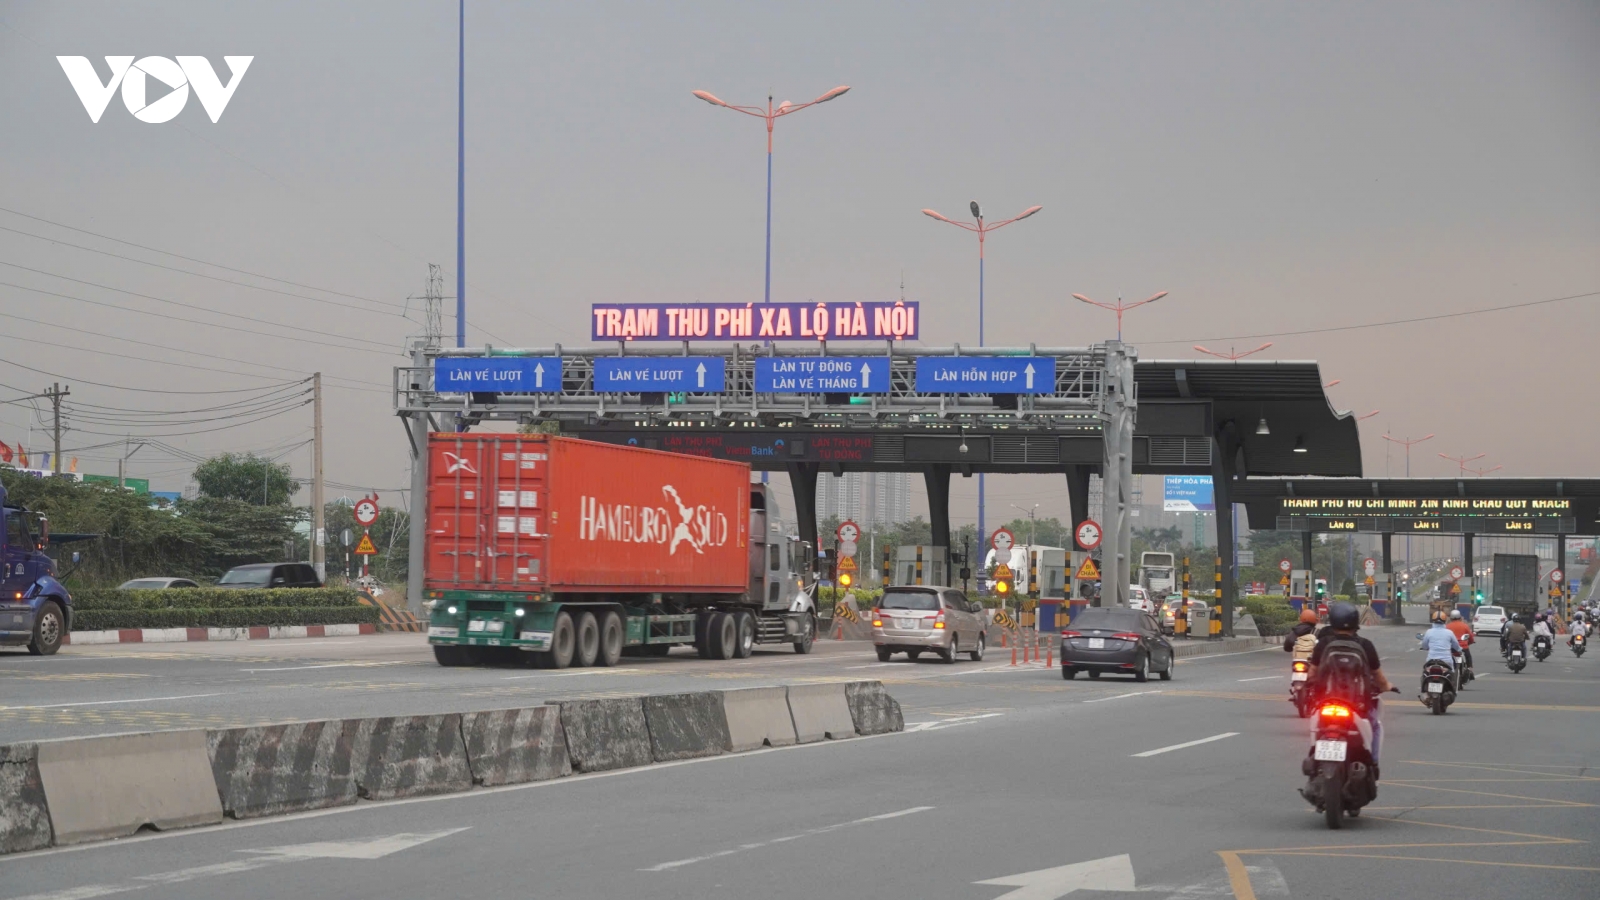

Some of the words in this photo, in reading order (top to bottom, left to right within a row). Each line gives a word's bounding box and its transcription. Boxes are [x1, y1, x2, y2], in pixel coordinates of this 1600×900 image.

[594, 308, 658, 341] TRẠM
[665, 308, 709, 337] THU
[714, 302, 753, 337] PHÍ
[758, 307, 793, 337] XA
[800, 302, 829, 341] LỘ
[835, 302, 868, 336] HÀ
[874, 301, 915, 341] NỘI
[773, 360, 796, 373] LÀN
[799, 361, 816, 375] TỰ
[818, 360, 853, 375] ĐỘNG
[450, 368, 472, 381] LÀN
[475, 368, 489, 381] VÉ
[493, 370, 523, 383] LƯỢT
[609, 368, 632, 381] LÀN
[635, 368, 650, 381] VÉ
[653, 370, 684, 383] LƯỢT
[934, 368, 958, 381] LÀN
[961, 366, 988, 381] HỖN
[991, 371, 1018, 384] HỢP
[773, 376, 796, 389] LÀN
[799, 376, 814, 389] VÉ
[817, 376, 858, 389] THÁNG
[832, 437, 852, 448] THU
[1184, 477, 1198, 485] HÒA
[580, 495, 667, 545] HAMBURG
[1329, 520, 1344, 529] LÀN
[1413, 520, 1429, 529] LÀN
[1430, 521, 1440, 529] 11
[1505, 521, 1522, 529] LÀN
[1523, 522, 1532, 530] 13
